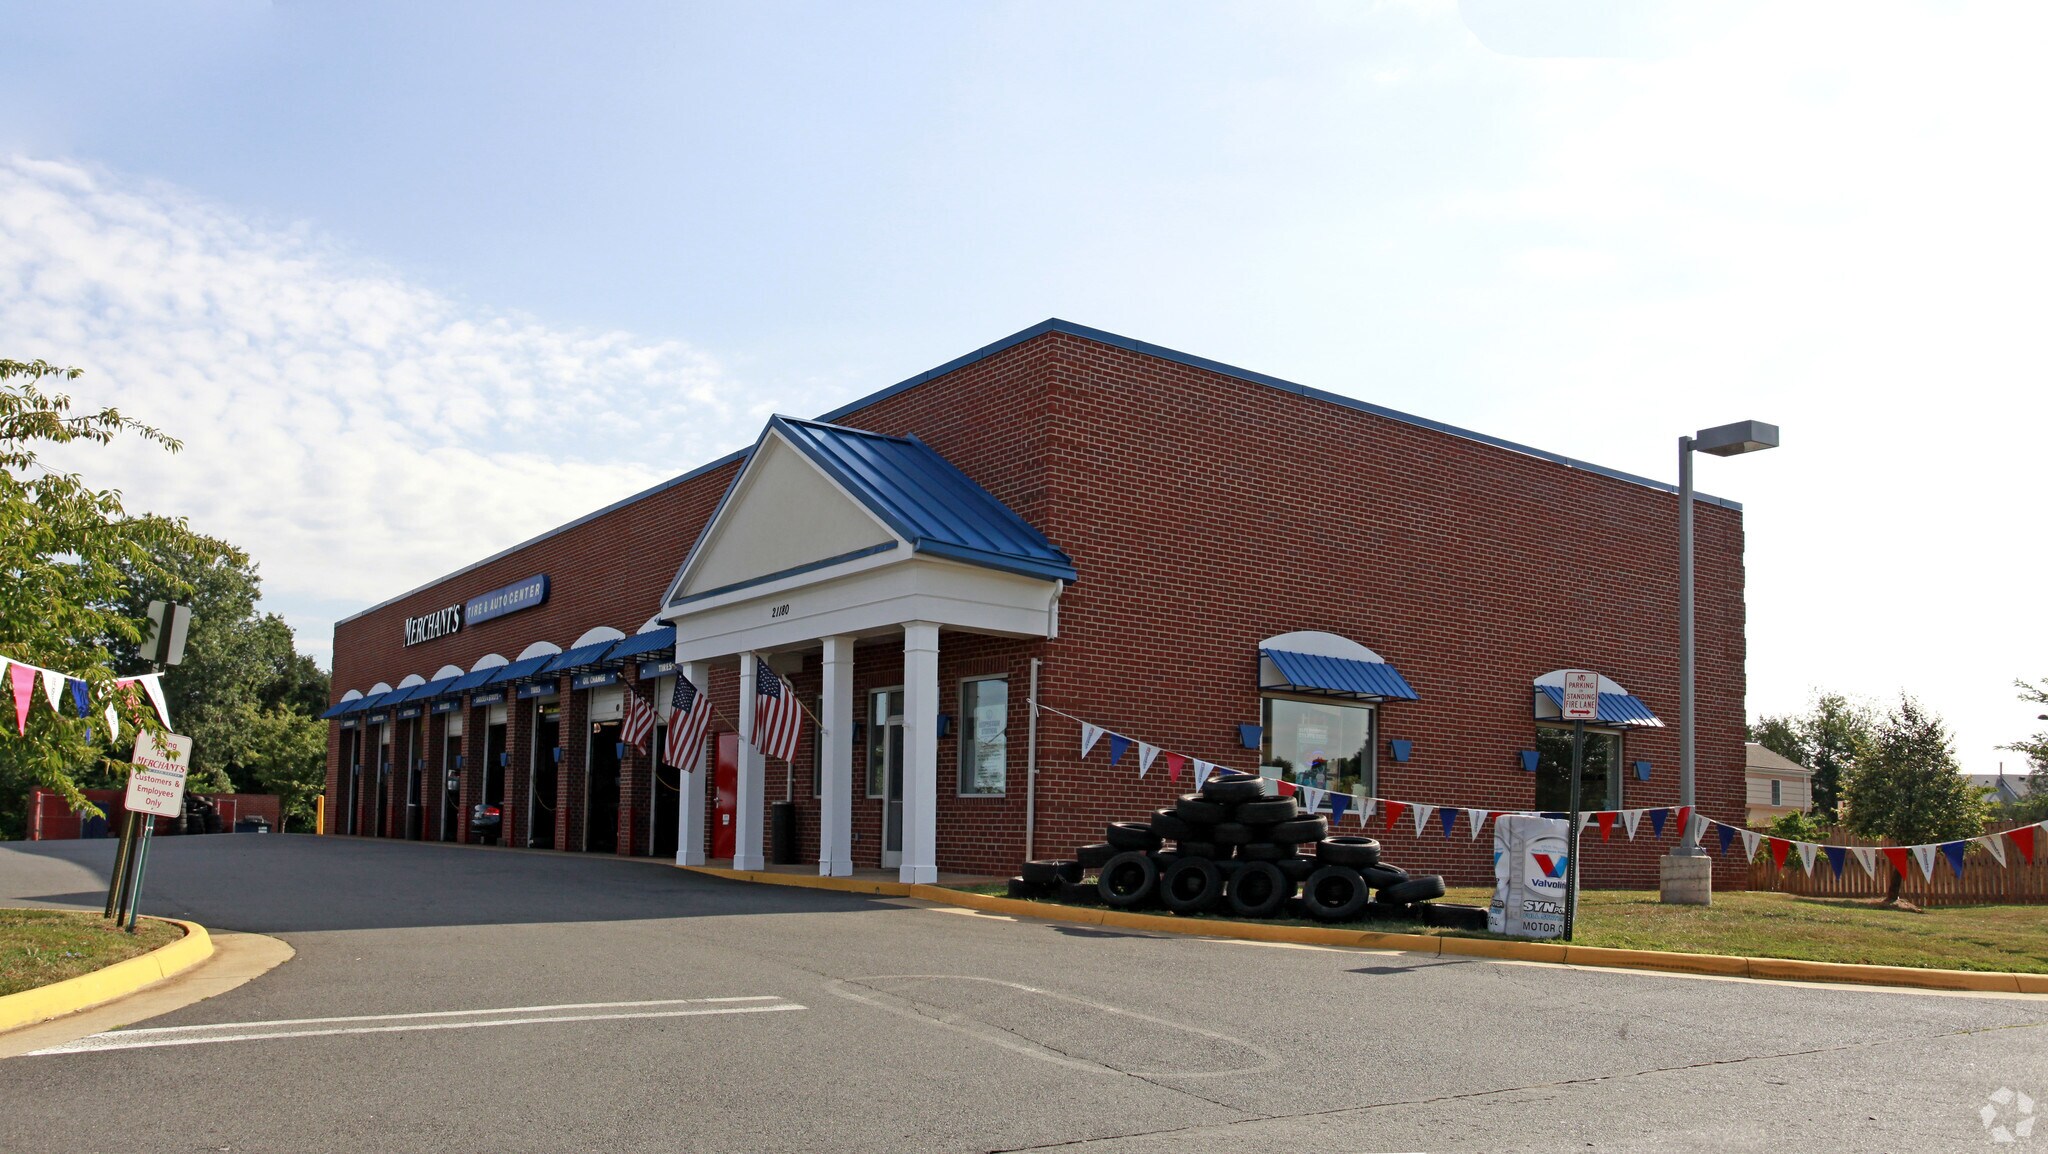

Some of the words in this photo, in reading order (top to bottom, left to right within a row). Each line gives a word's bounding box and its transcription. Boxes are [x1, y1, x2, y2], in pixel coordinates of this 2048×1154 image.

[467, 604, 482, 619] TIRE
[484, 601, 488, 612] &
[403, 604, 461, 648] MERCHANT'S
[151, 737, 178, 750] Ping
[135, 772, 172, 787] Customers
[175, 780, 180, 788] &
[137, 784, 174, 798] Employees
[146, 797, 162, 808] Only
[1532, 878, 1566, 890] Valvolin
[1523, 921, 1556, 933] MOTOR
